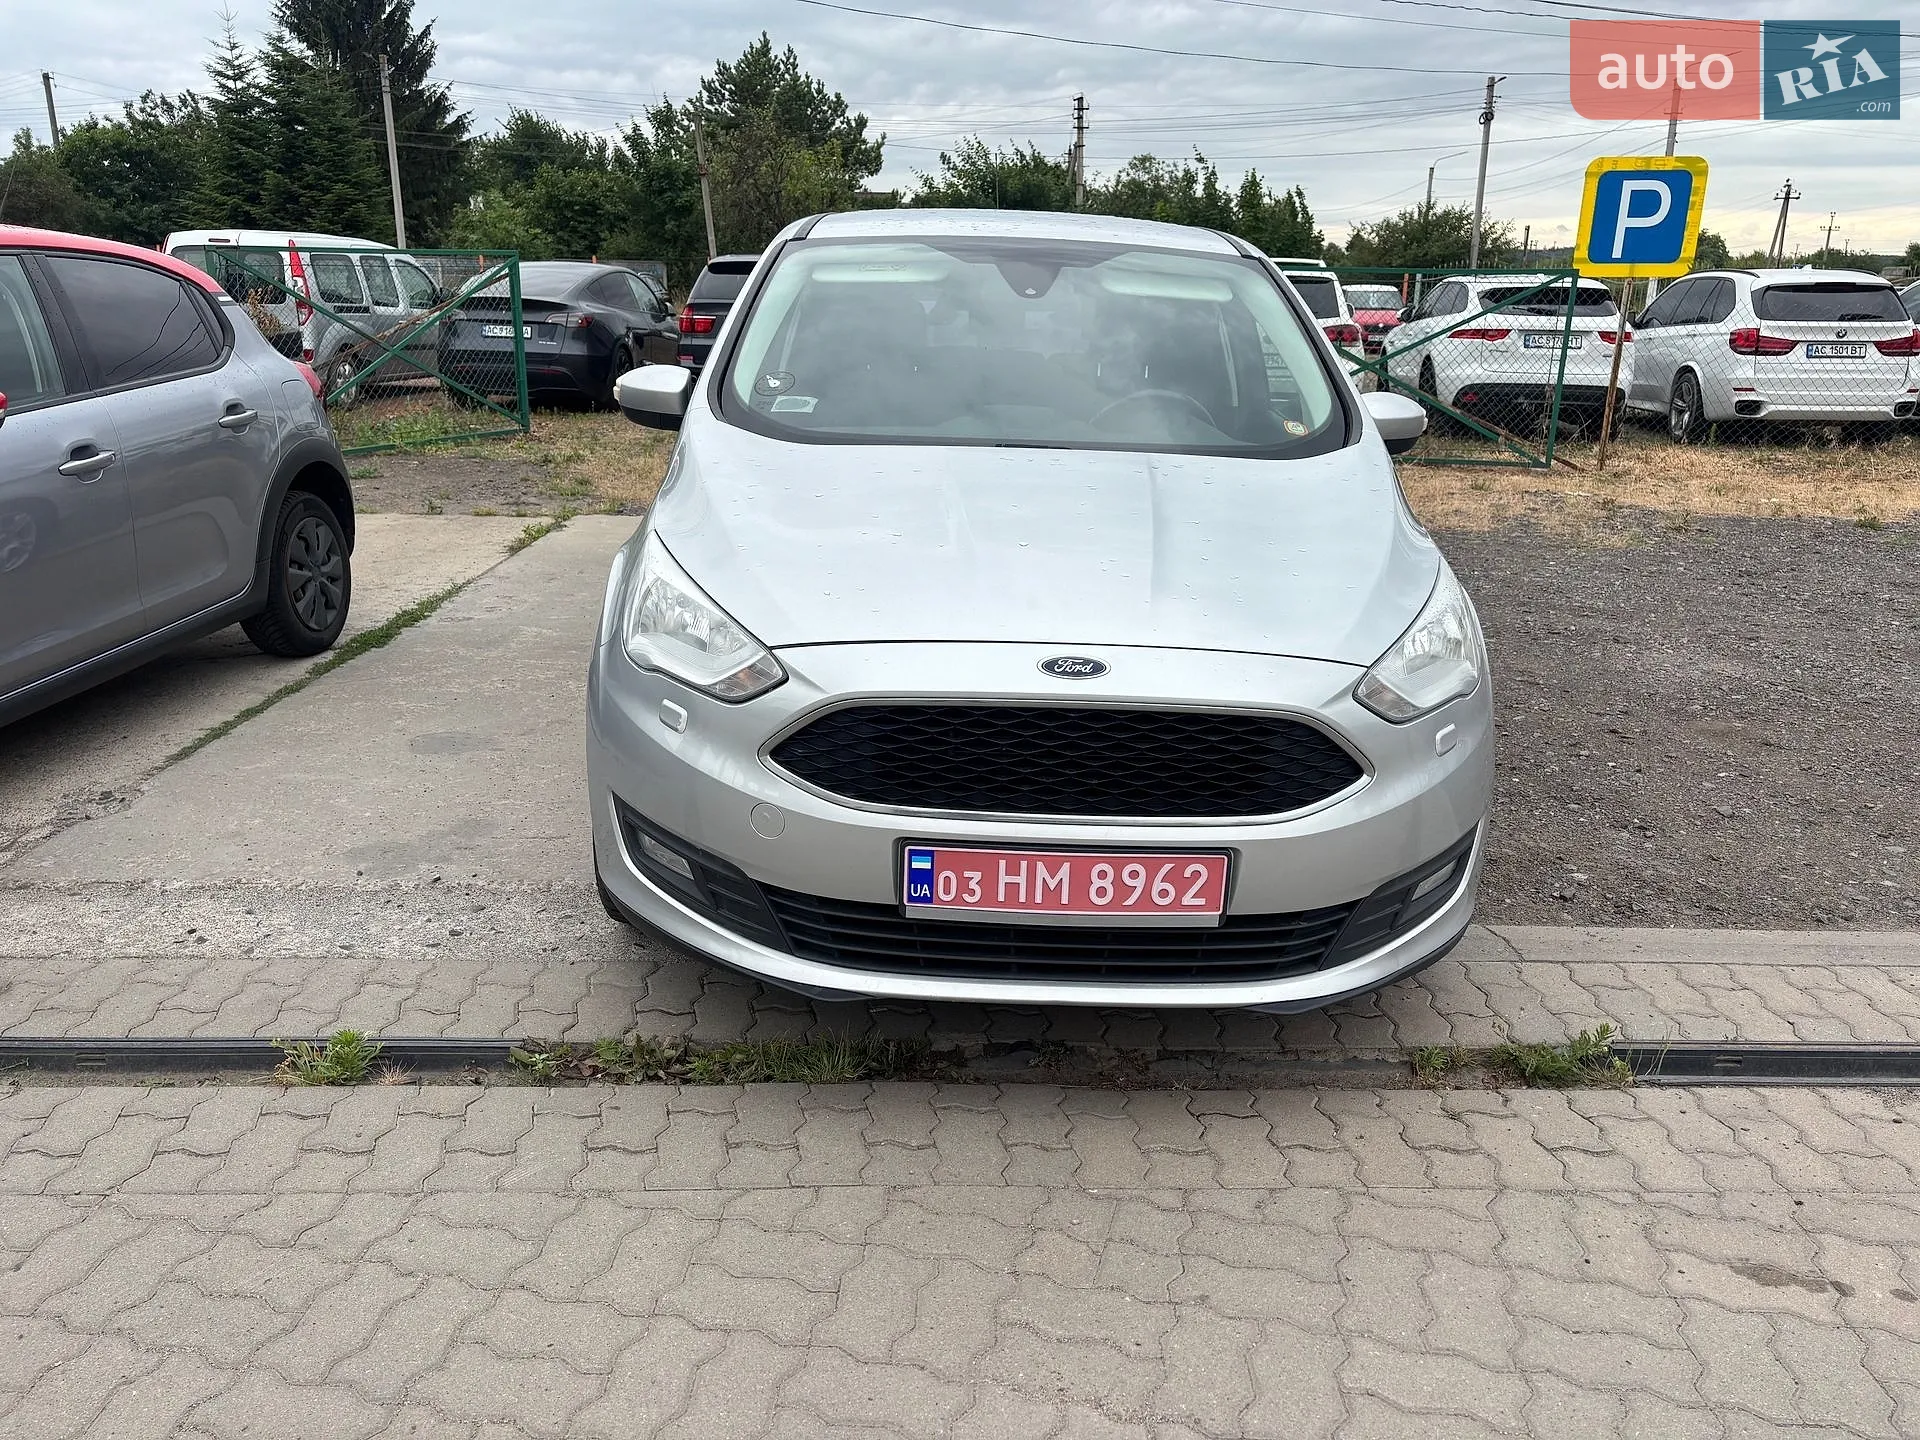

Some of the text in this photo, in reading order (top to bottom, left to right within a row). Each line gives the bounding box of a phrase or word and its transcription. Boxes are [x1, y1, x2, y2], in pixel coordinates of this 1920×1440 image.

[1611, 179, 1672, 259] P
[1531, 336, 1544, 345] AC
[1813, 345, 1864, 355] AC 1501 BT
[1053, 658, 1094, 673] Ford
[910, 883, 931, 898] UA
[937, 859, 1209, 907] 03 HM 8962
